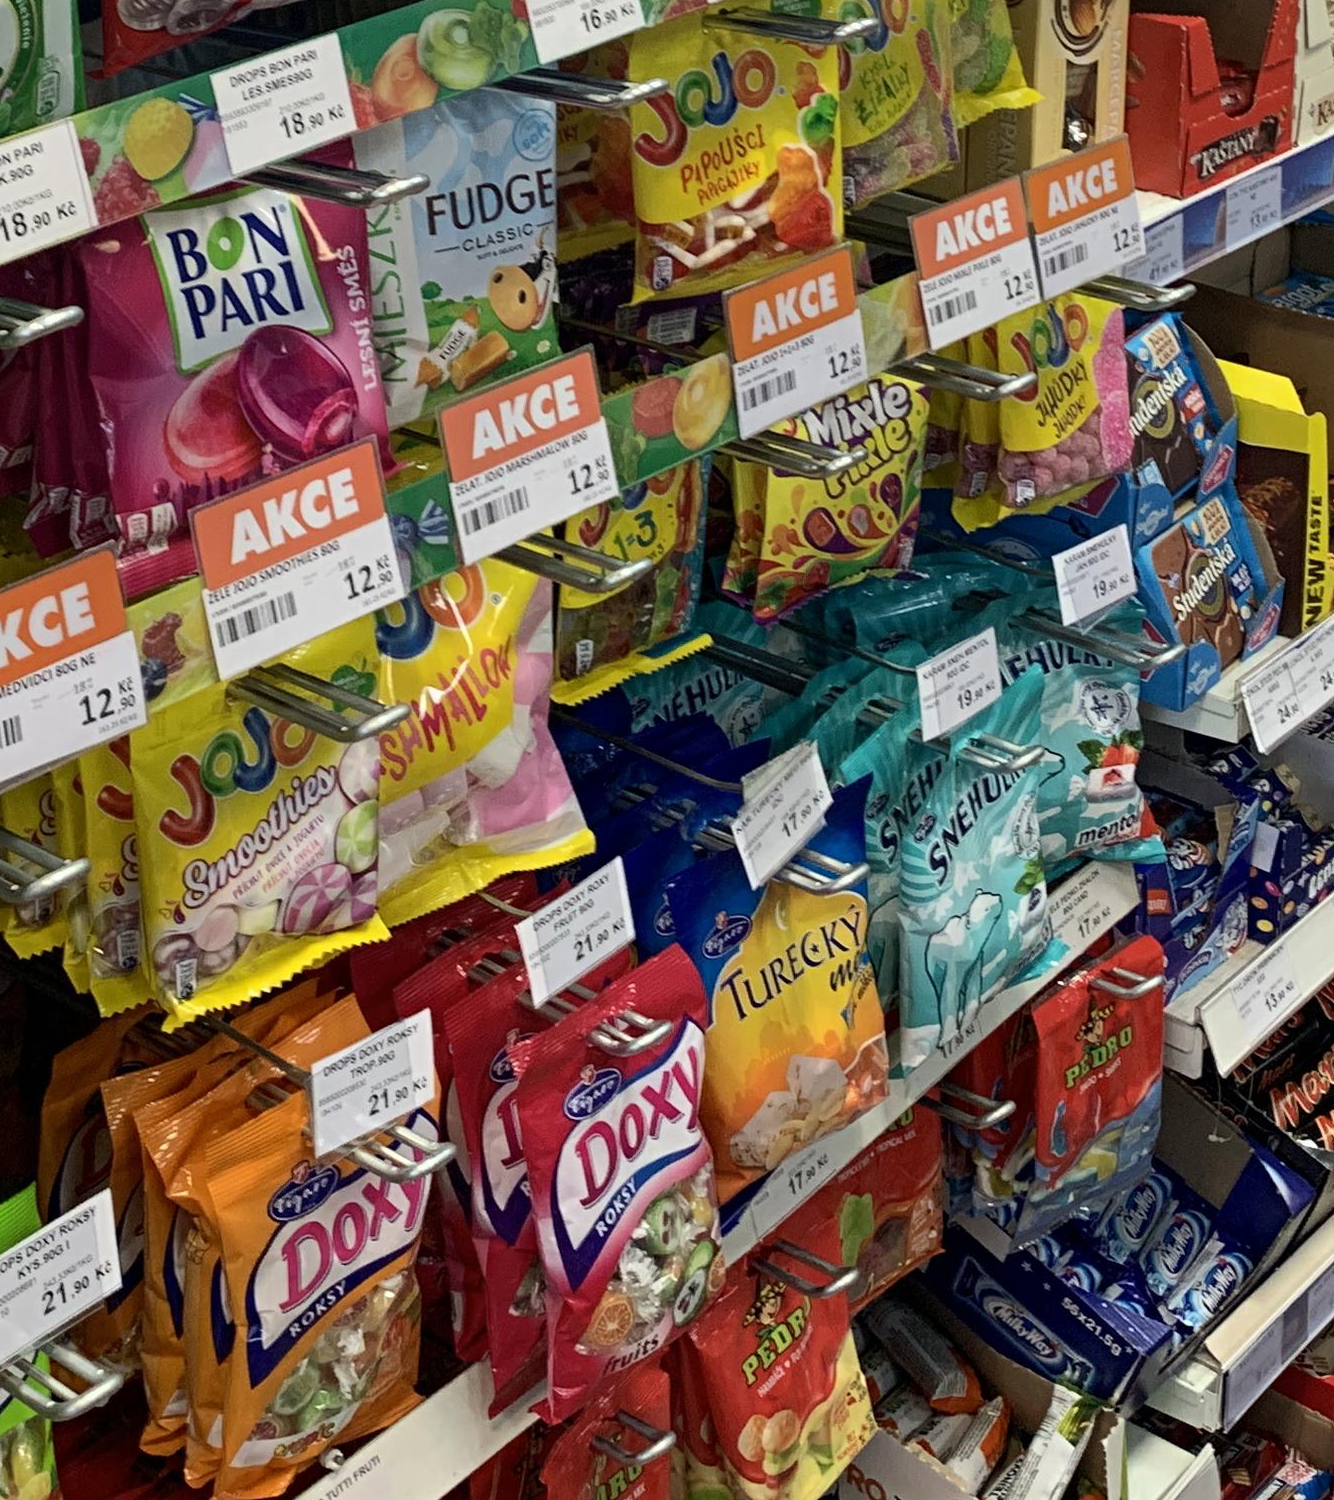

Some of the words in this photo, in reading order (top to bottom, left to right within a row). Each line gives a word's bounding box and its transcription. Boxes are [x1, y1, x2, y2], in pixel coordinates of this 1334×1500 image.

[12, 140, 45, 165] PARI
[56, 201, 78, 222] Kč
[426, 168, 556, 236] FUDGE
[1046, 157, 1119, 219] AKCE
[165, 202, 292, 284] BON
[462, 223, 534, 252] CLASSIC
[935, 196, 1014, 264] AKCE
[179, 258, 308, 341] PARI
[750, 275, 840, 345] AKCE
[472, 374, 583, 459] AKCE
[799, 379, 913, 447] Mixle
[229, 466, 361, 564] AKCE
[1307, 489, 1327, 555] TASTE
[1172, 538, 1236, 621] Studentská
[1304, 558, 1328, 631] NEW
[181, 763, 340, 910] Smoothies
[718, 902, 865, 1023] TURECKÝ
[1063, 1018, 1136, 1092] PEDRO
[573, 1044, 703, 1209] Doxy
[593, 1180, 641, 1239] ROKSY
[95, 1260, 113, 1281] Kč
[287, 1279, 349, 1339] ROKSY
